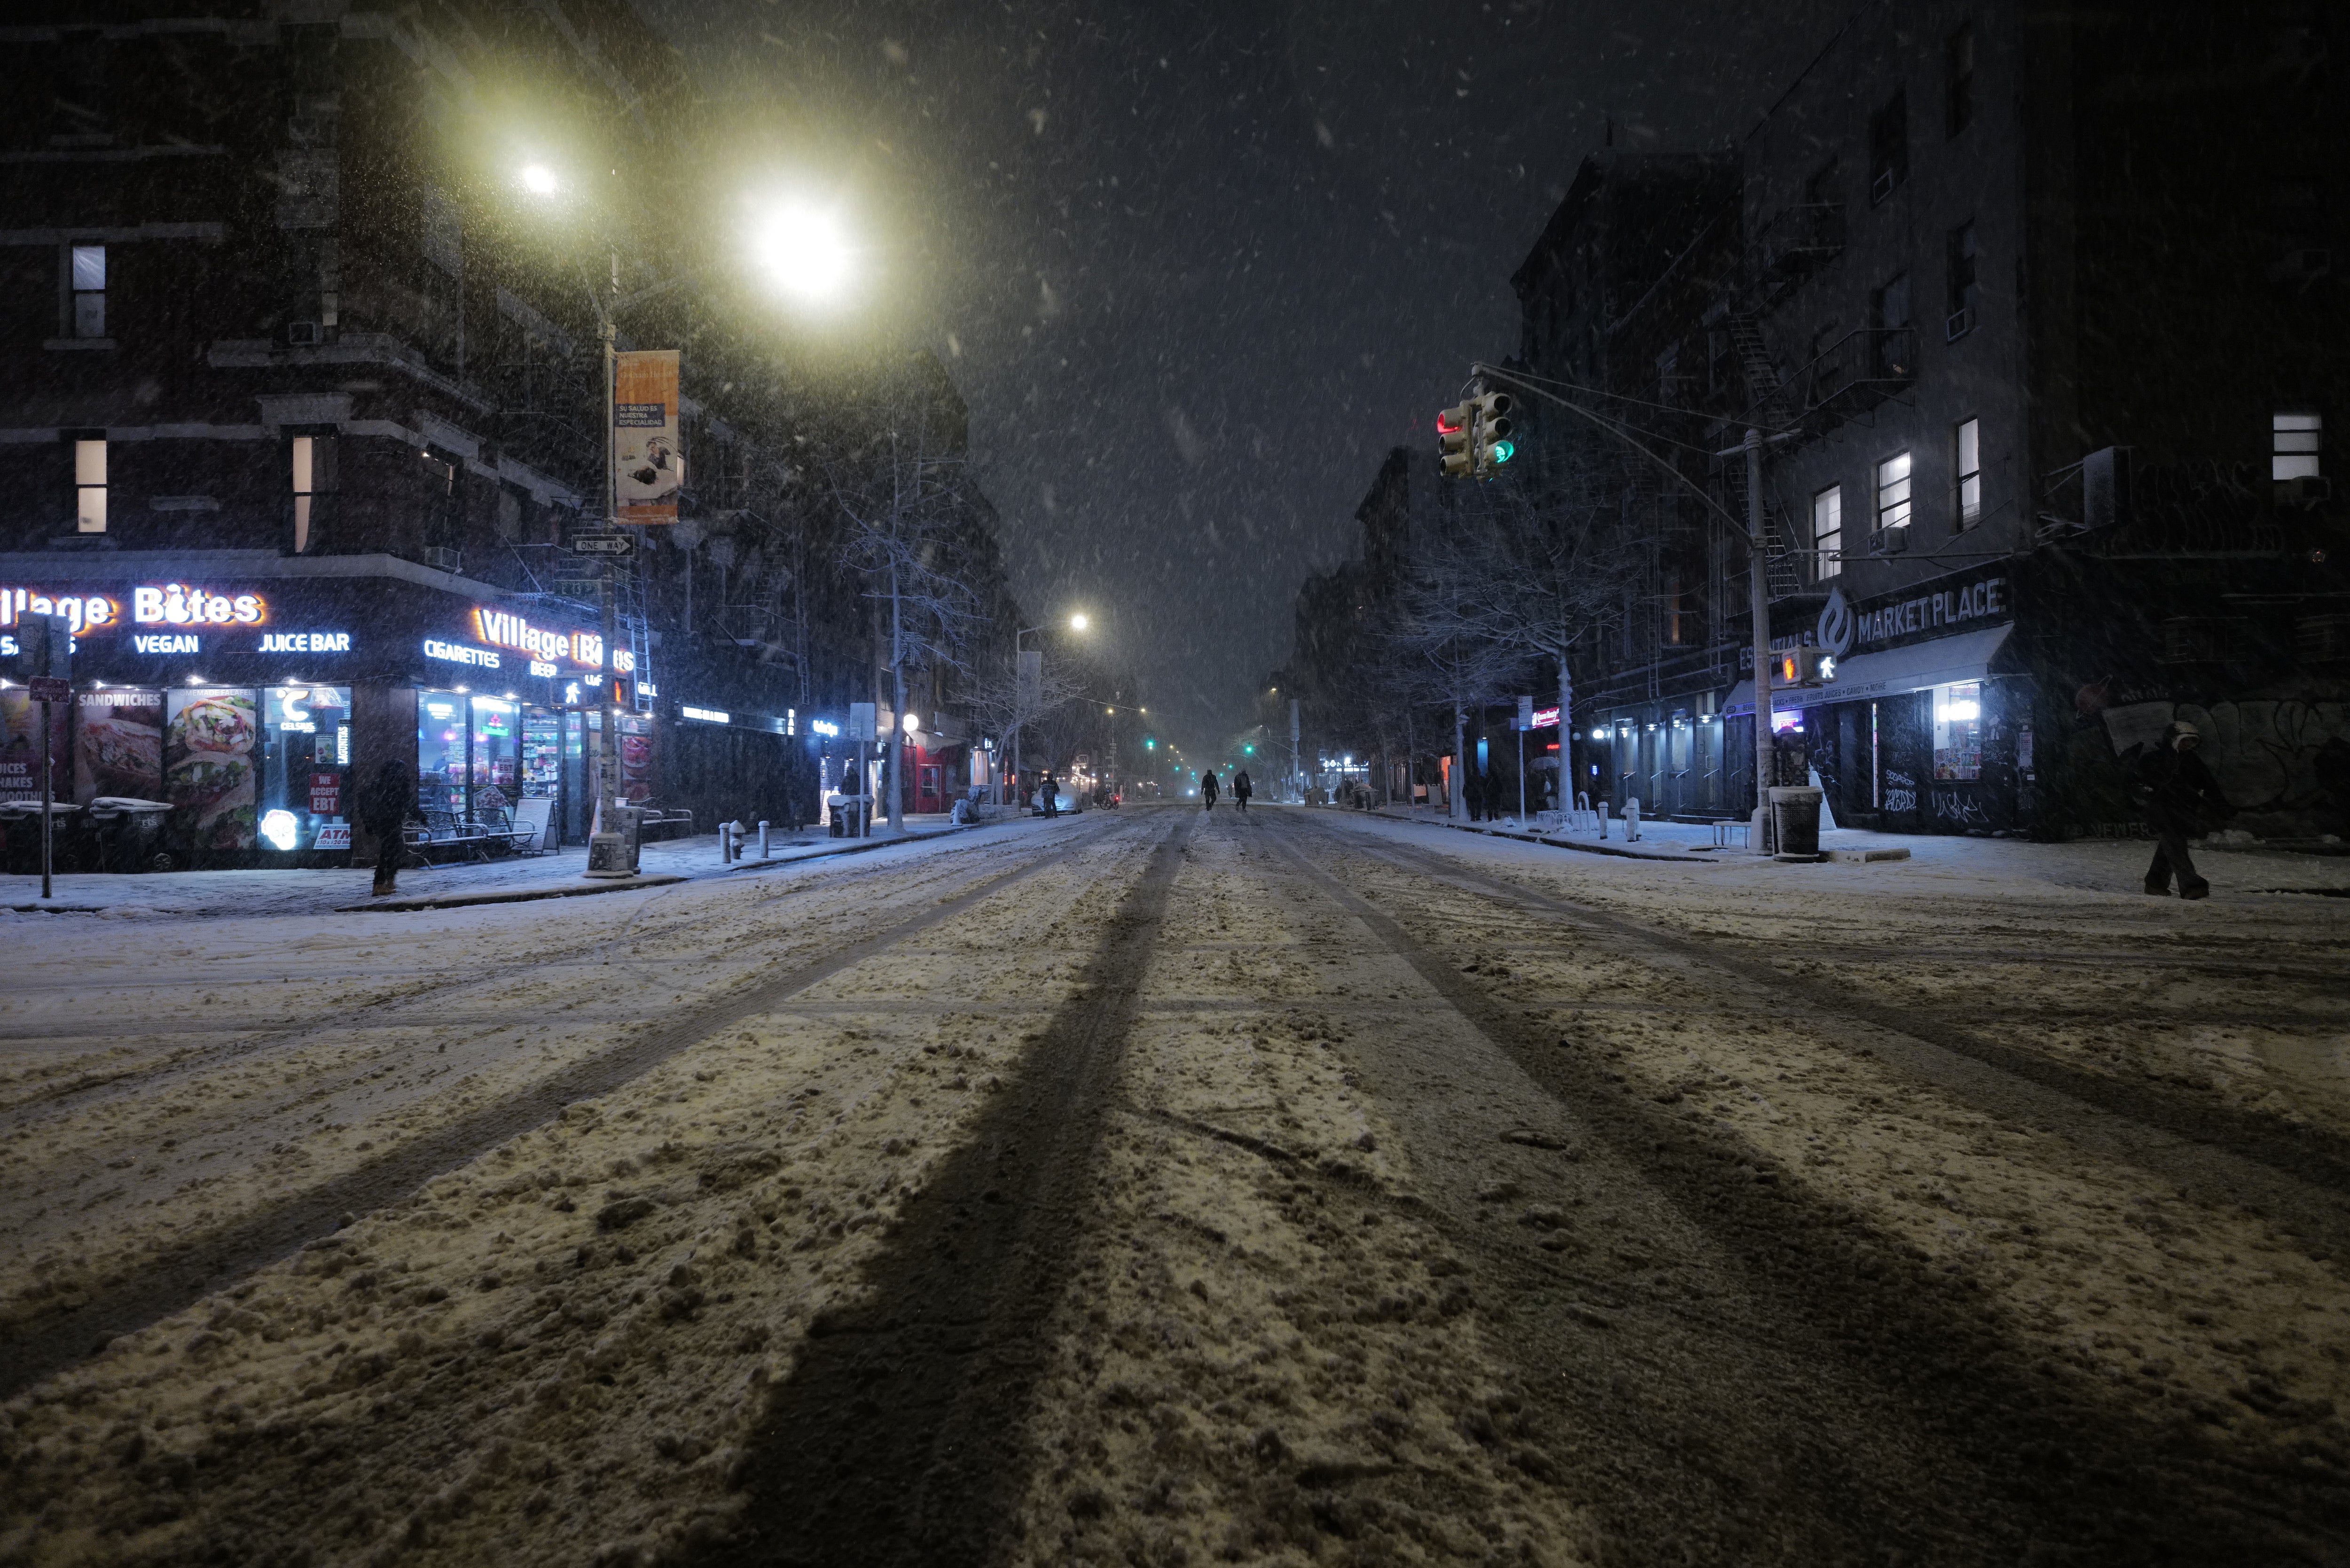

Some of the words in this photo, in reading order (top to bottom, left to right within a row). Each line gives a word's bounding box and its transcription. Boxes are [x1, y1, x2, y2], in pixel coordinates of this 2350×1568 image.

[135, 584, 260, 623] Bites
[1858, 597, 1929, 644] MARKET
[1932, 578, 2001, 626] PLACE
[135, 635, 199, 653] VEGAN
[258, 634, 308, 652] JUICE
[311, 634, 350, 651] BAR
[483, 609, 569, 661] Village
[580, 634, 634, 671] Bies
[424, 640, 500, 668] CIGARETTES
[531, 661, 557, 678] BEER
[79, 694, 161, 706] SANDWICHES
[1807, 692, 1823, 702] FRUITS
[1825, 689, 1841, 699] JUICES
[1847, 686, 1864, 695] CANDY
[1870, 682, 1887, 692] MORE
[281, 722, 315, 731] CELSIUS
[338, 726, 348, 764] LAGUNITAS
[313, 797, 336, 811] EBT
